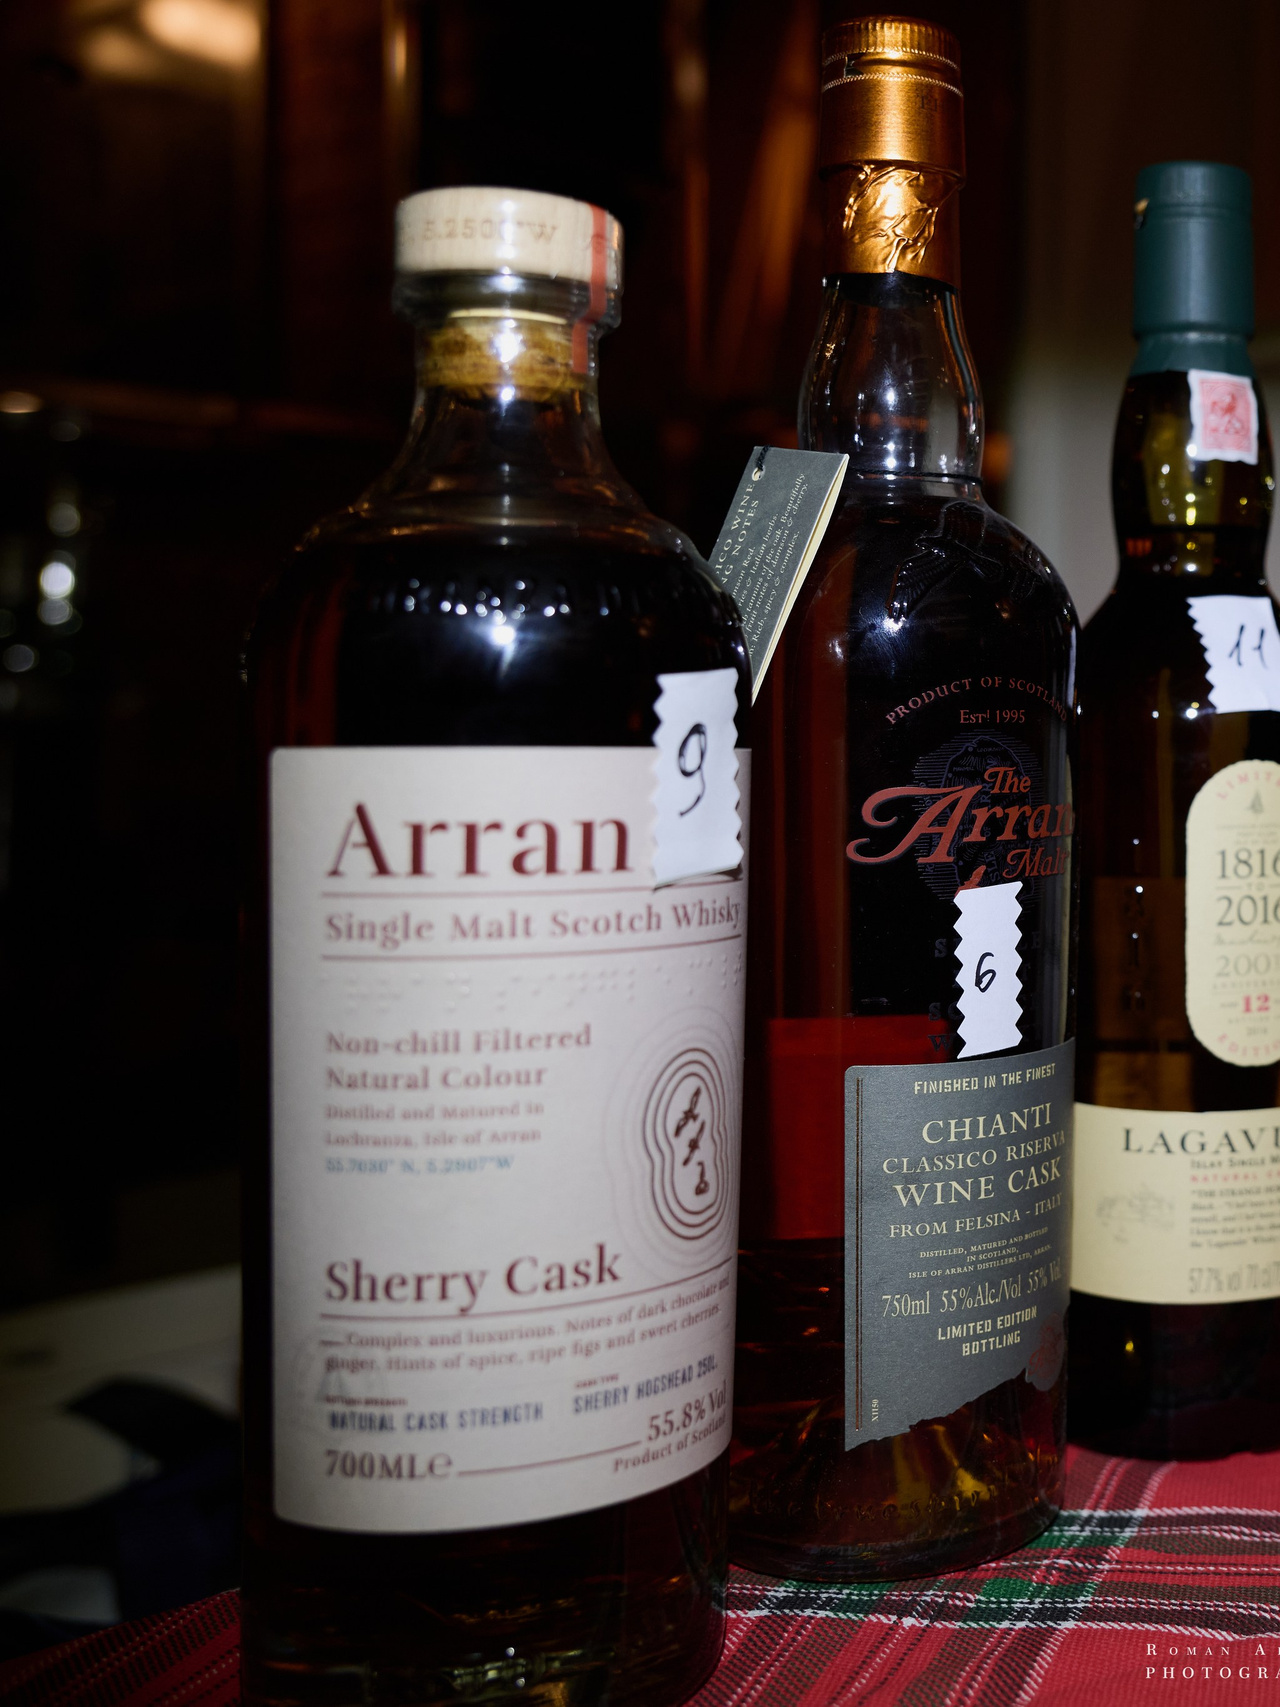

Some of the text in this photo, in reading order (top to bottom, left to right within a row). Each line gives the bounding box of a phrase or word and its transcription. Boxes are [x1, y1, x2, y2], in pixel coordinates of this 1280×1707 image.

[731, 483, 755, 531] WINE
[732, 499, 758, 556] NOTES
[742, 546, 756, 568] Red.
[746, 472, 806, 615] tannins oak. Beautifully
[750, 512, 778, 575] Italian herbs.
[757, 581, 769, 607] notes
[771, 530, 789, 570] damson
[792, 481, 809, 516] cherry.
[753, 530, 800, 643] Rich, spicy complex.
[1228, 623, 1269, 670] 11
[885, 676, 1068, 725] PRODUCT OF SCOTLAND
[995, 709, 1026, 724] 1995
[678, 722, 708, 818] 9
[983, 766, 1031, 795] The
[325, 802, 635, 878] Arran
[846, 784, 1075, 864] Arran
[1002, 849, 1069, 880] Malt
[325, 898, 741, 949] Single Malt Scotch Whisky
[975, 951, 997, 993] 6
[1242, 993, 1271, 1015] 12
[325, 1023, 592, 1056] Non-chill Filtered
[325, 1063, 547, 1091] Natural Colour
[914, 1062, 1057, 1095] FINISHED IN THE FINEST
[921, 1102, 1053, 1145] CHIANTI
[882, 1130, 1066, 1175] CLASSICO RISERVA
[892, 1156, 1062, 1208] WINE CASK
[889, 1192, 1063, 1239] FROM FELSINA ITALY
[919, 1226, 1049, 1259] DISTILLED, MATURED BOTTLED
[978, 1246, 1020, 1261] SCOTLAND,
[324, 1258, 488, 1316] Sherry
[505, 1243, 623, 1296] Cask
[908, 1256, 1017, 1279] ISLE OF ARRAN DISTILLERS
[881, 1290, 931, 1318] 750ml
[1026, 1268, 1048, 1294] 55%
[564, 1300, 667, 1335] Notes dark
[608, 1331, 635, 1349] and
[639, 1321, 677, 1340] sweet
[938, 1305, 1038, 1341] LIMITED EDITION
[962, 1330, 1021, 1357] BOTTLING
[573, 1386, 630, 1415] SHERRY
[635, 1364, 694, 1400] HOGSHEAD
[871, 1399, 879, 1422] X1150
[328, 1401, 544, 1433] NATURAL CASK STRENGTH
[647, 1393, 706, 1442] 55.8%
